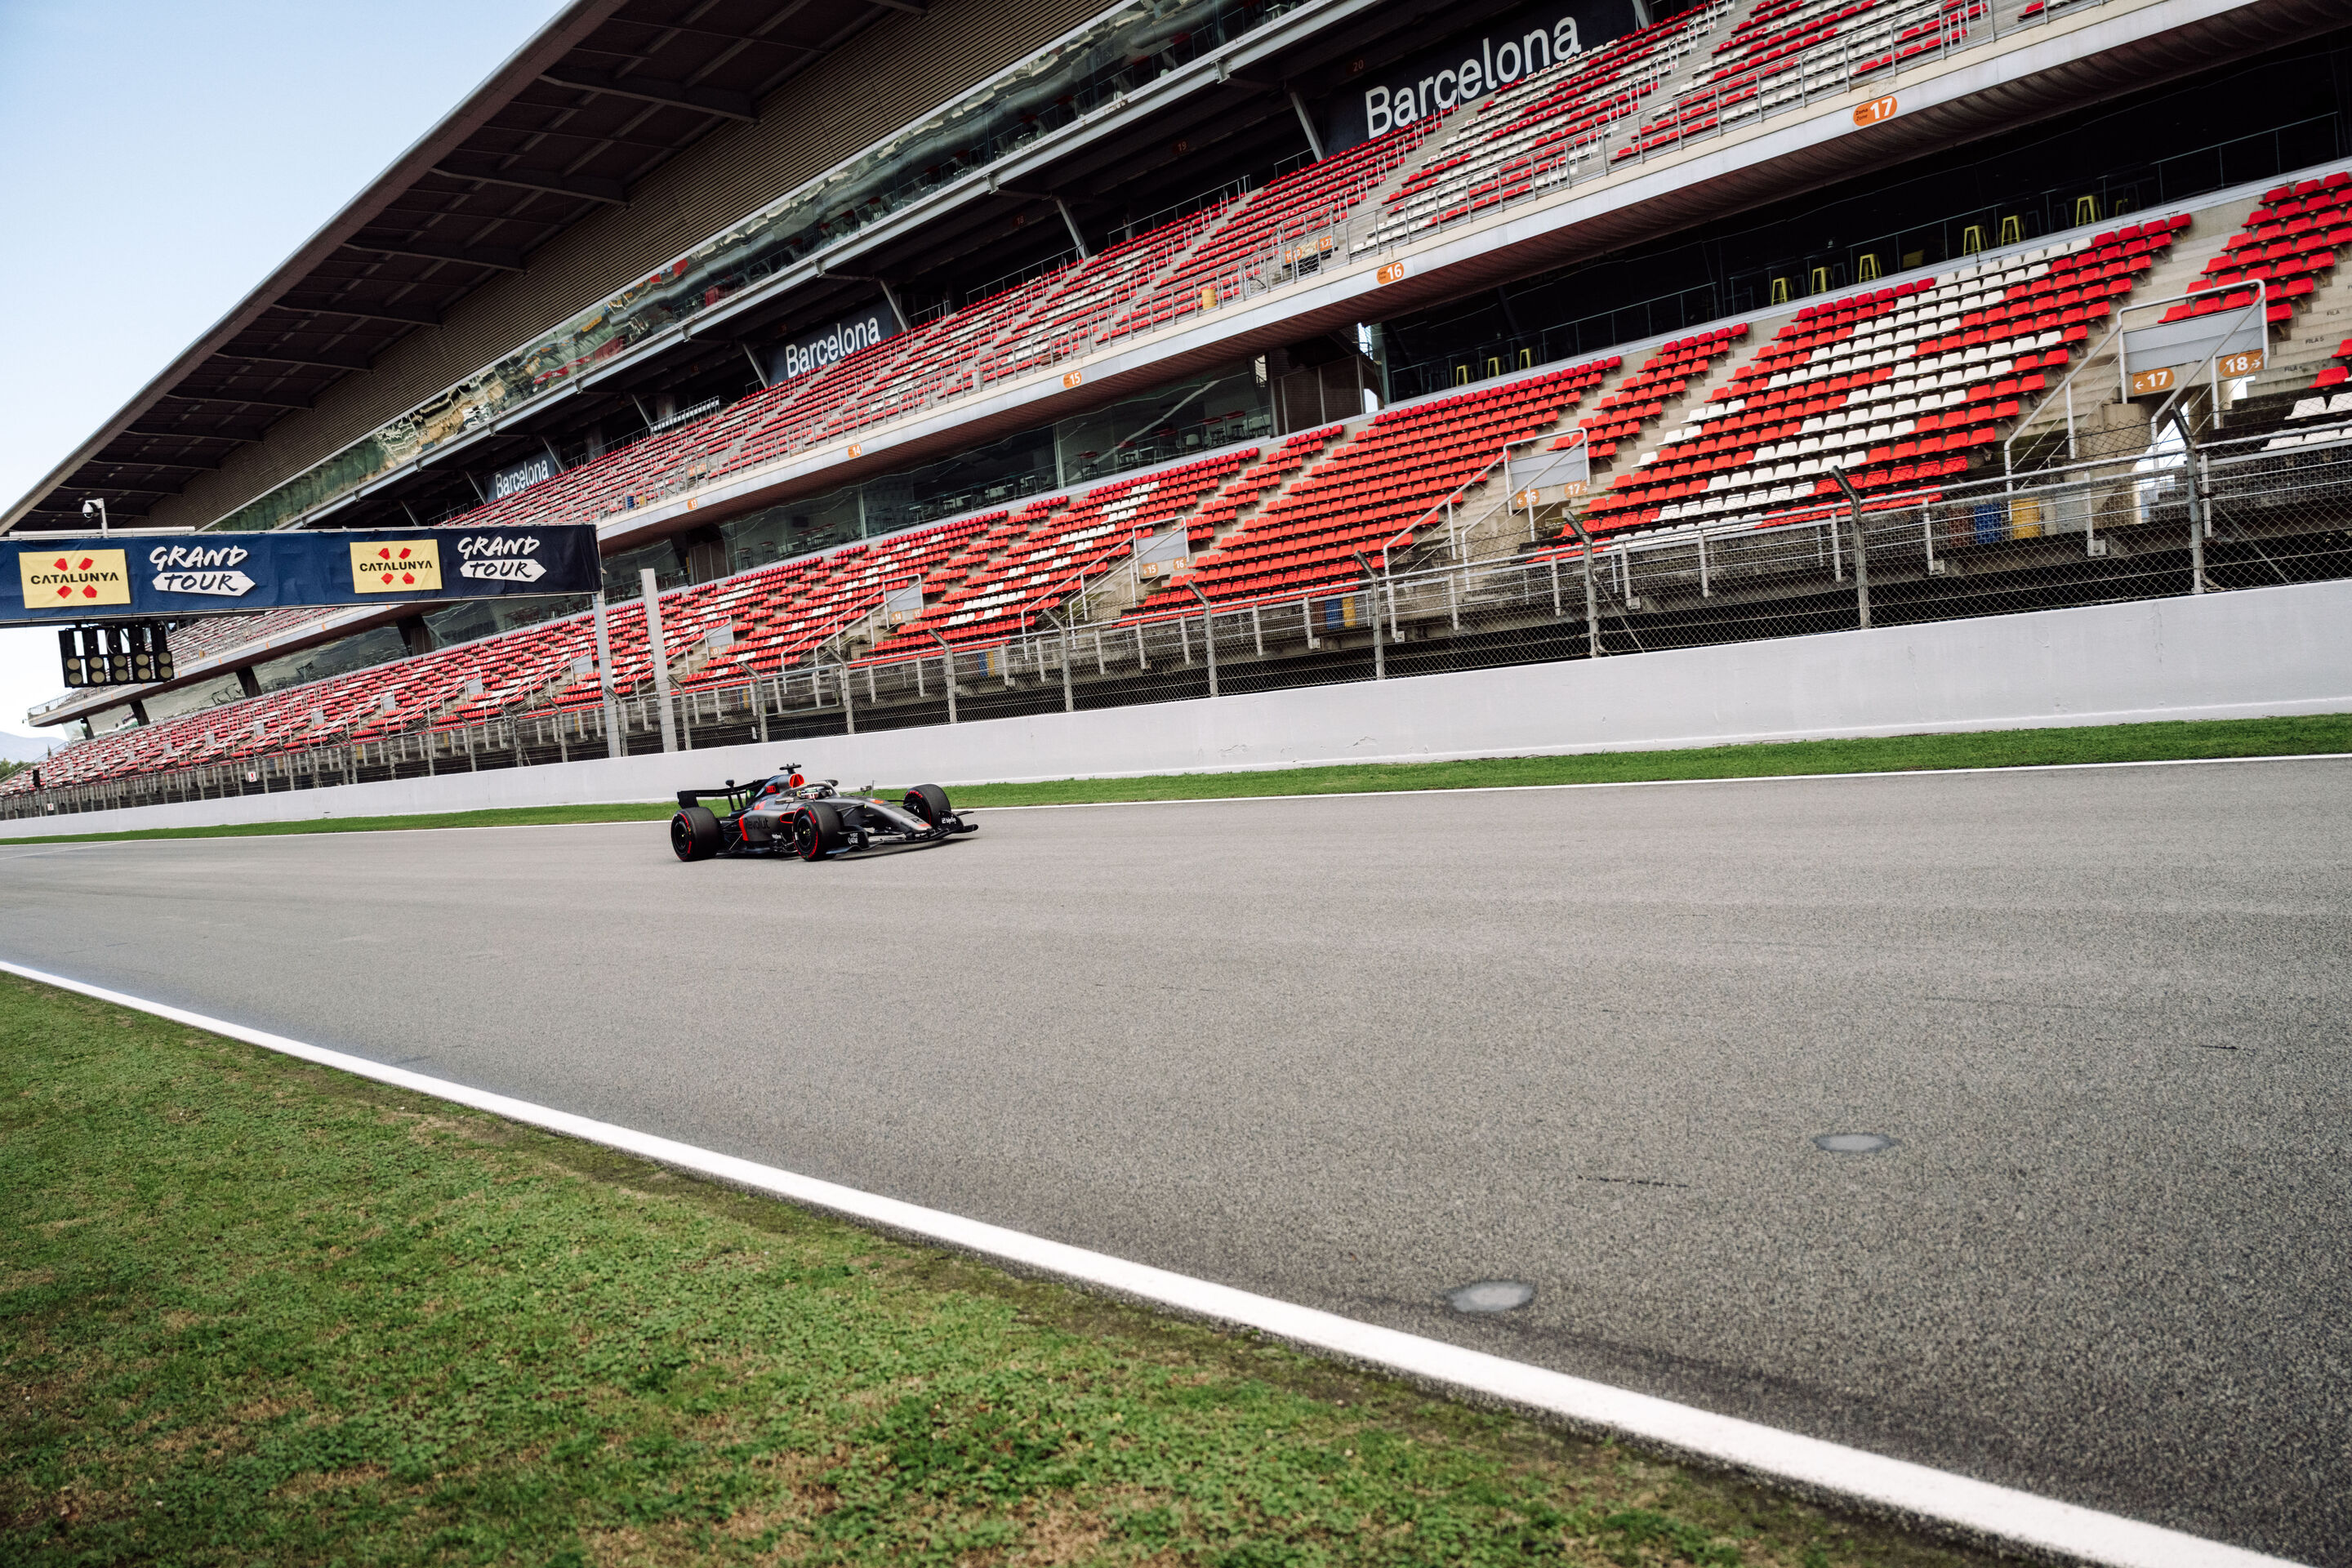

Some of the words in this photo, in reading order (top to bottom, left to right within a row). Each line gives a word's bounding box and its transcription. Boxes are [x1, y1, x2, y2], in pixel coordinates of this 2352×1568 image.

[1352, 60, 1364, 72] 20
[1365, 16, 1582, 140] Barcelona
[1870, 97, 1893, 119] 17
[1388, 264, 1402, 280] 16
[786, 317, 881, 378] Barcelona
[2225, 356, 2248, 373] 18
[1070, 372, 1081, 385] 15
[2147, 371, 2168, 387] 17
[853, 445, 861, 457] 14
[495, 460, 550, 499] Barcelona
[1524, 492, 1537, 503] 16
[1568, 483, 1580, 496] 17
[457, 536, 541, 560] GRAND
[149, 545, 248, 572] GRAND
[359, 560, 433, 572] CATALUNYA
[1176, 559, 1184, 569] 16
[470, 562, 532, 578] TOUR
[1148, 564, 1156, 574] 15
[30, 572, 119, 585] CATALUNYA
[164, 573, 238, 592] TOUR
[744, 817, 770, 830] Revolut
